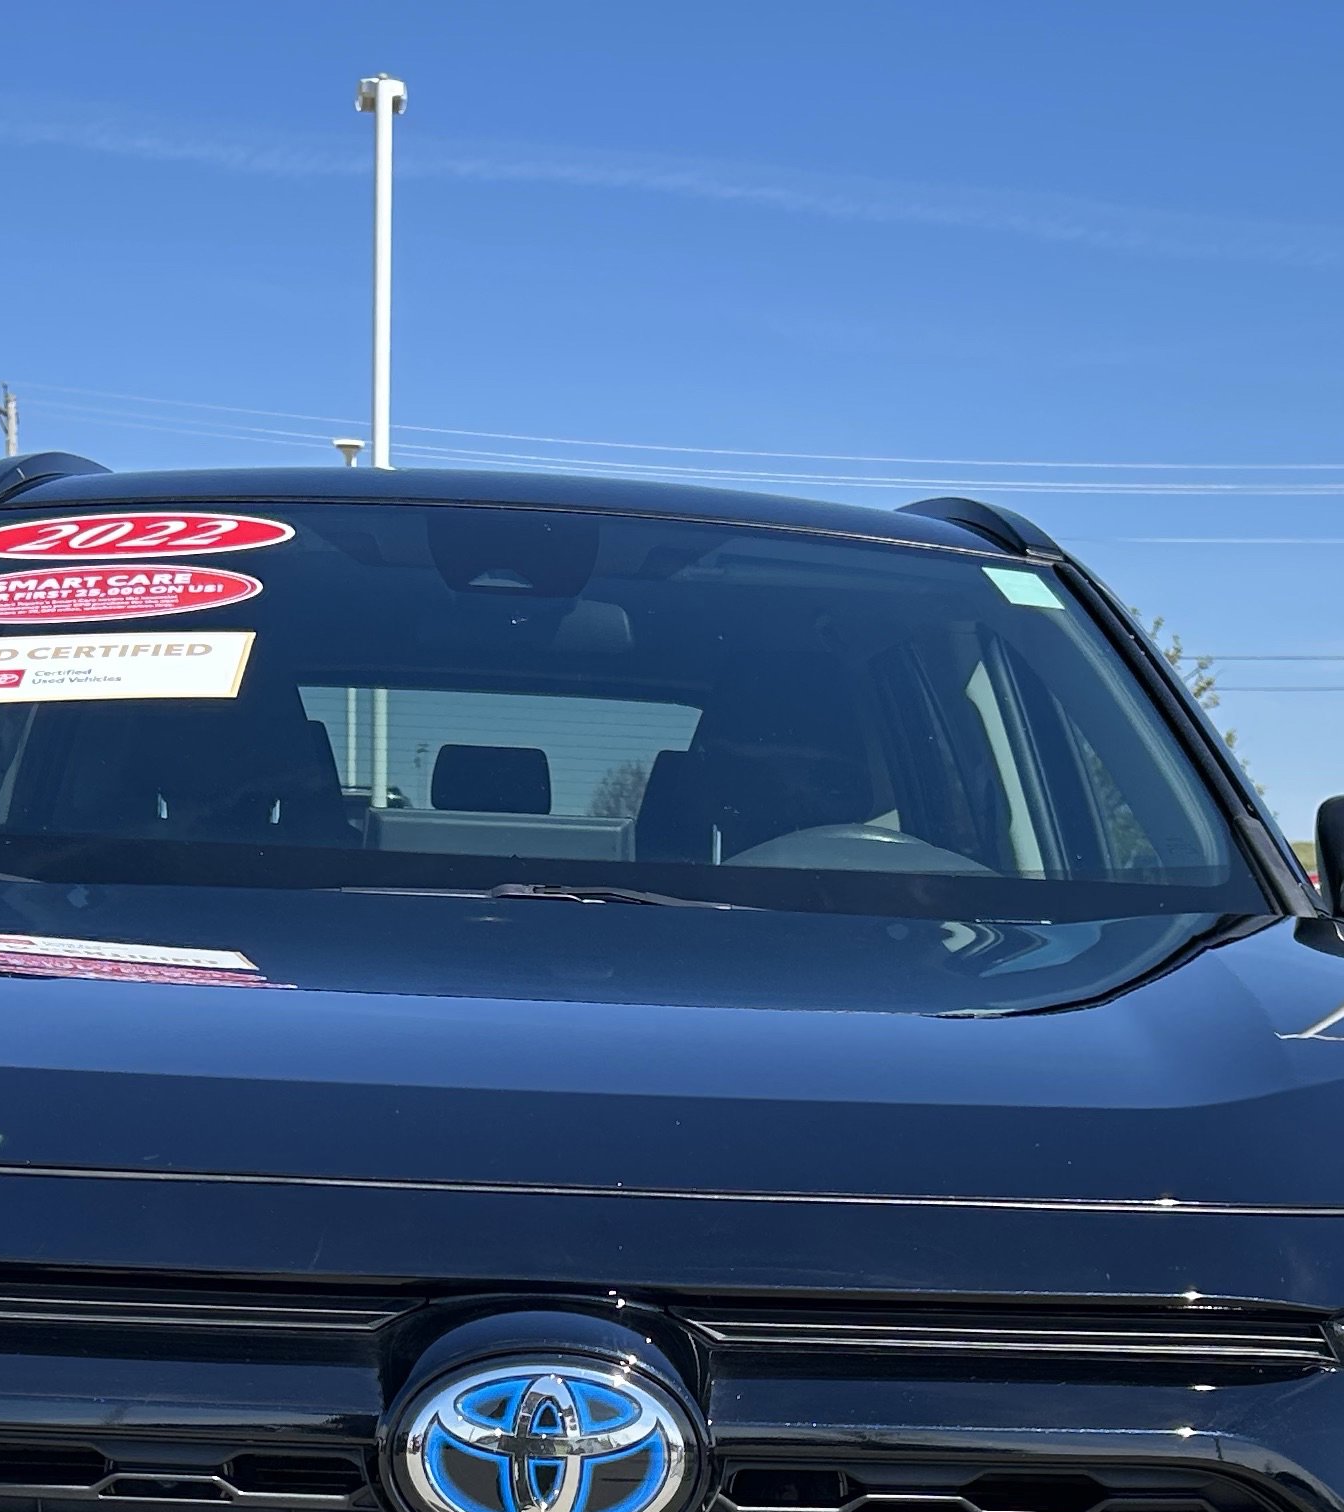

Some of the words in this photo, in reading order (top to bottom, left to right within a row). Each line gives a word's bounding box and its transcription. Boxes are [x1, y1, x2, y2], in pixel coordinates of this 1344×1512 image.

[7, 520, 239, 551] 2022
[106, 573, 192, 587] CARE
[13, 589, 72, 601] FIRST
[149, 585, 185, 594] ON
[188, 583, 224, 593] US!
[27, 643, 213, 660] CERTIFIED
[31, 677, 65, 685] Used
[68, 675, 122, 683] Vehicles
[34, 668, 92, 677] Certified
